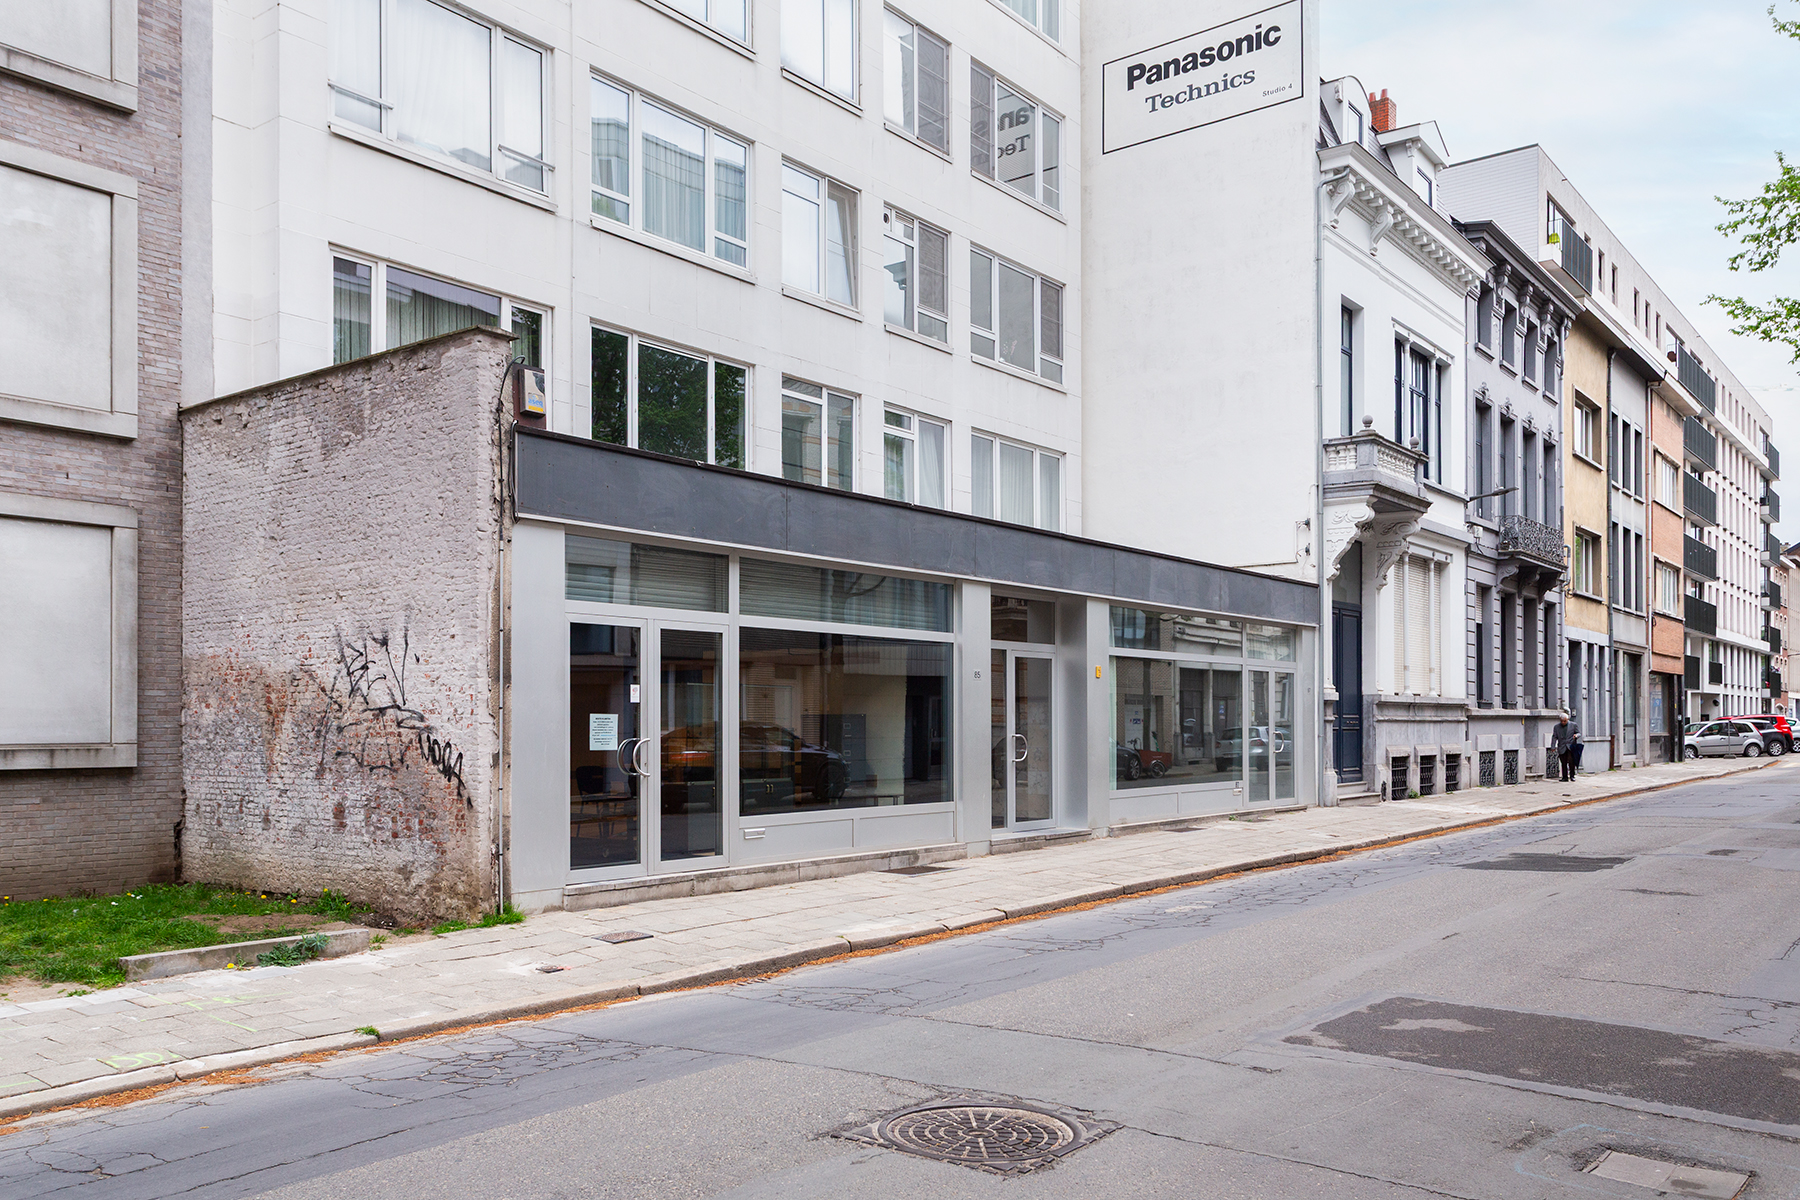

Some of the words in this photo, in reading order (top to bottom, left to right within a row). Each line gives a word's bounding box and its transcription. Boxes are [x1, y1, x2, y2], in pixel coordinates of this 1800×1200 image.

[1127, 24, 1282, 91] Panasonic
[1145, 70, 1256, 113] Technics
[1262, 86, 1286, 97] Studio
[974, 670, 981, 679] 85
